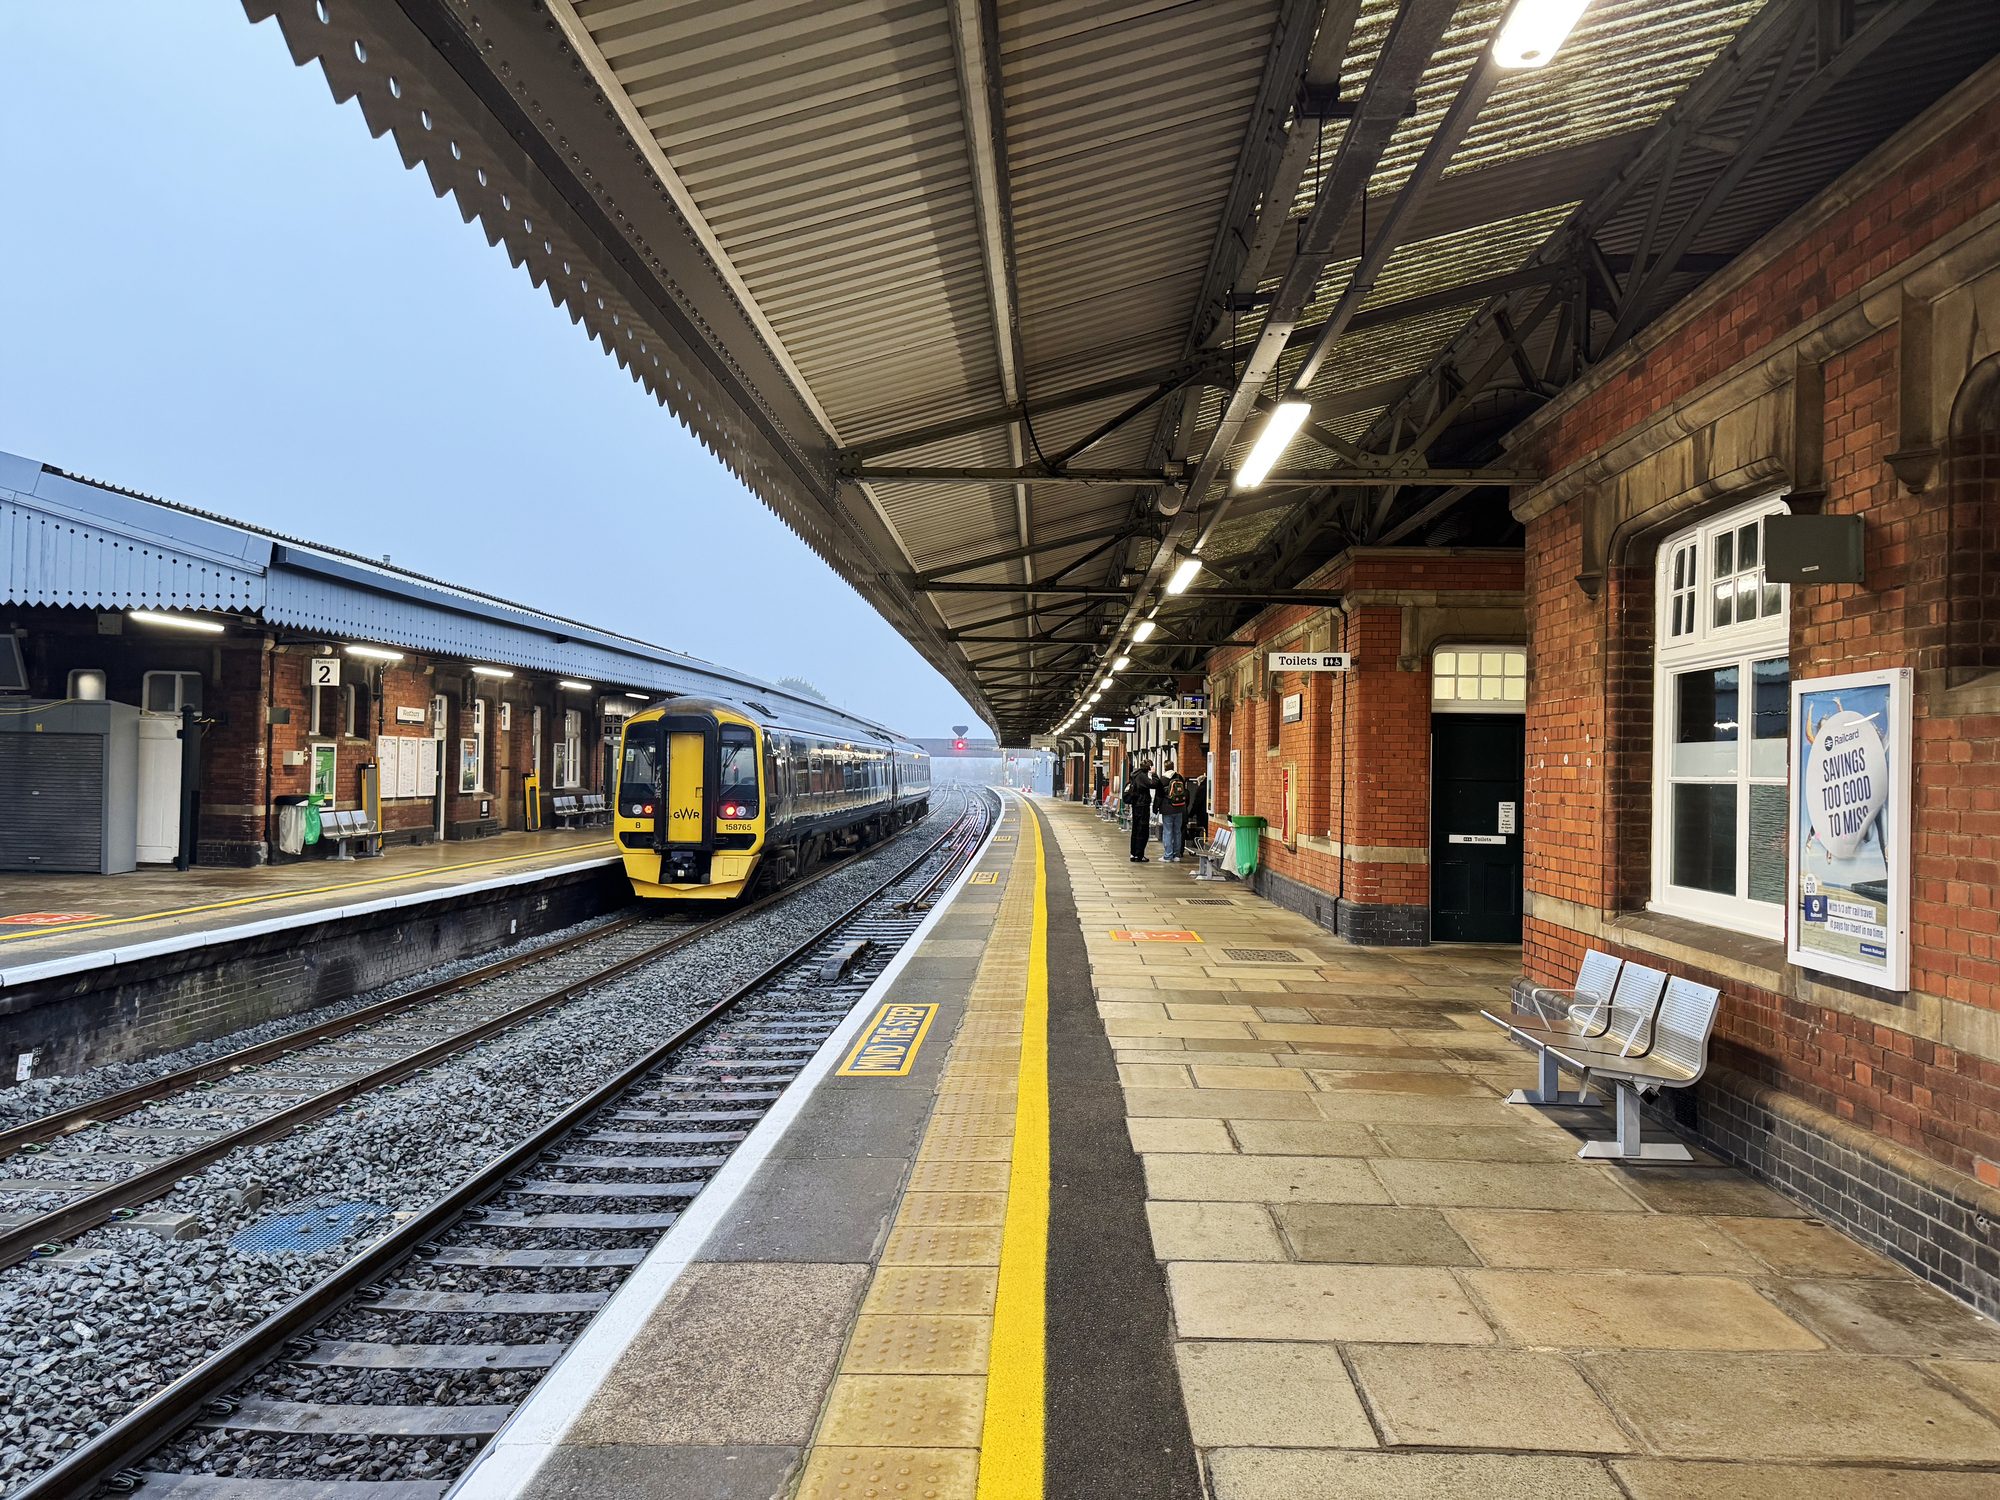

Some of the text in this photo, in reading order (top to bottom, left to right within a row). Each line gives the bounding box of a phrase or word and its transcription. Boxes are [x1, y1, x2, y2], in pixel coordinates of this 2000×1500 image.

[1279, 656, 1317, 666] Toilets
[318, 666, 330, 683] 2
[1834, 730, 1860, 746] Railcard
[1822, 747, 1866, 782] SAVINGS
[1822, 776, 1872, 810] TOO GOOD
[674, 808, 700, 820] GWR
[1828, 813, 1840, 838] TO
[1834, 921, 1844, 930] pays
[854, 1006, 926, 1070] MIND THE STEP
